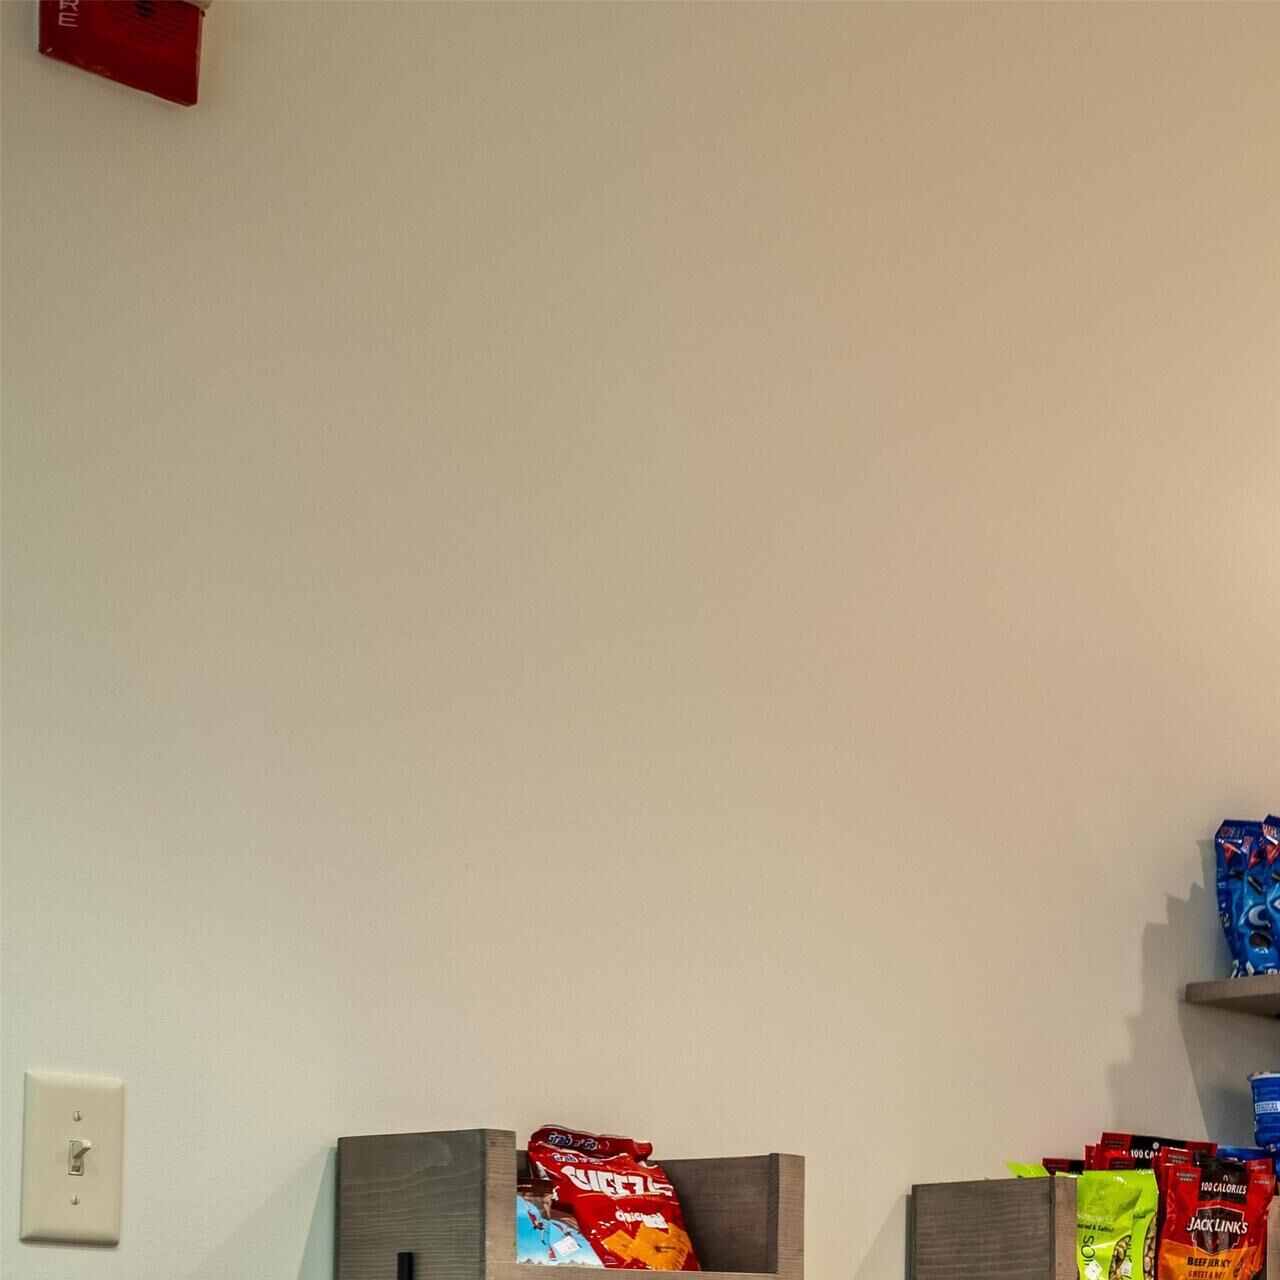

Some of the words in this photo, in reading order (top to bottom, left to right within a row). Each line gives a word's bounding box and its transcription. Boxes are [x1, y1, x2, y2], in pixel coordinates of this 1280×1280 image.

[547, 1132, 573, 1147] Grab
[1201, 1182, 1213, 1192] 100
[1213, 1183, 1247, 1194] CALORIES
[1187, 1216, 1214, 1232] JACK
[1187, 1256, 1207, 1267] BEEF
